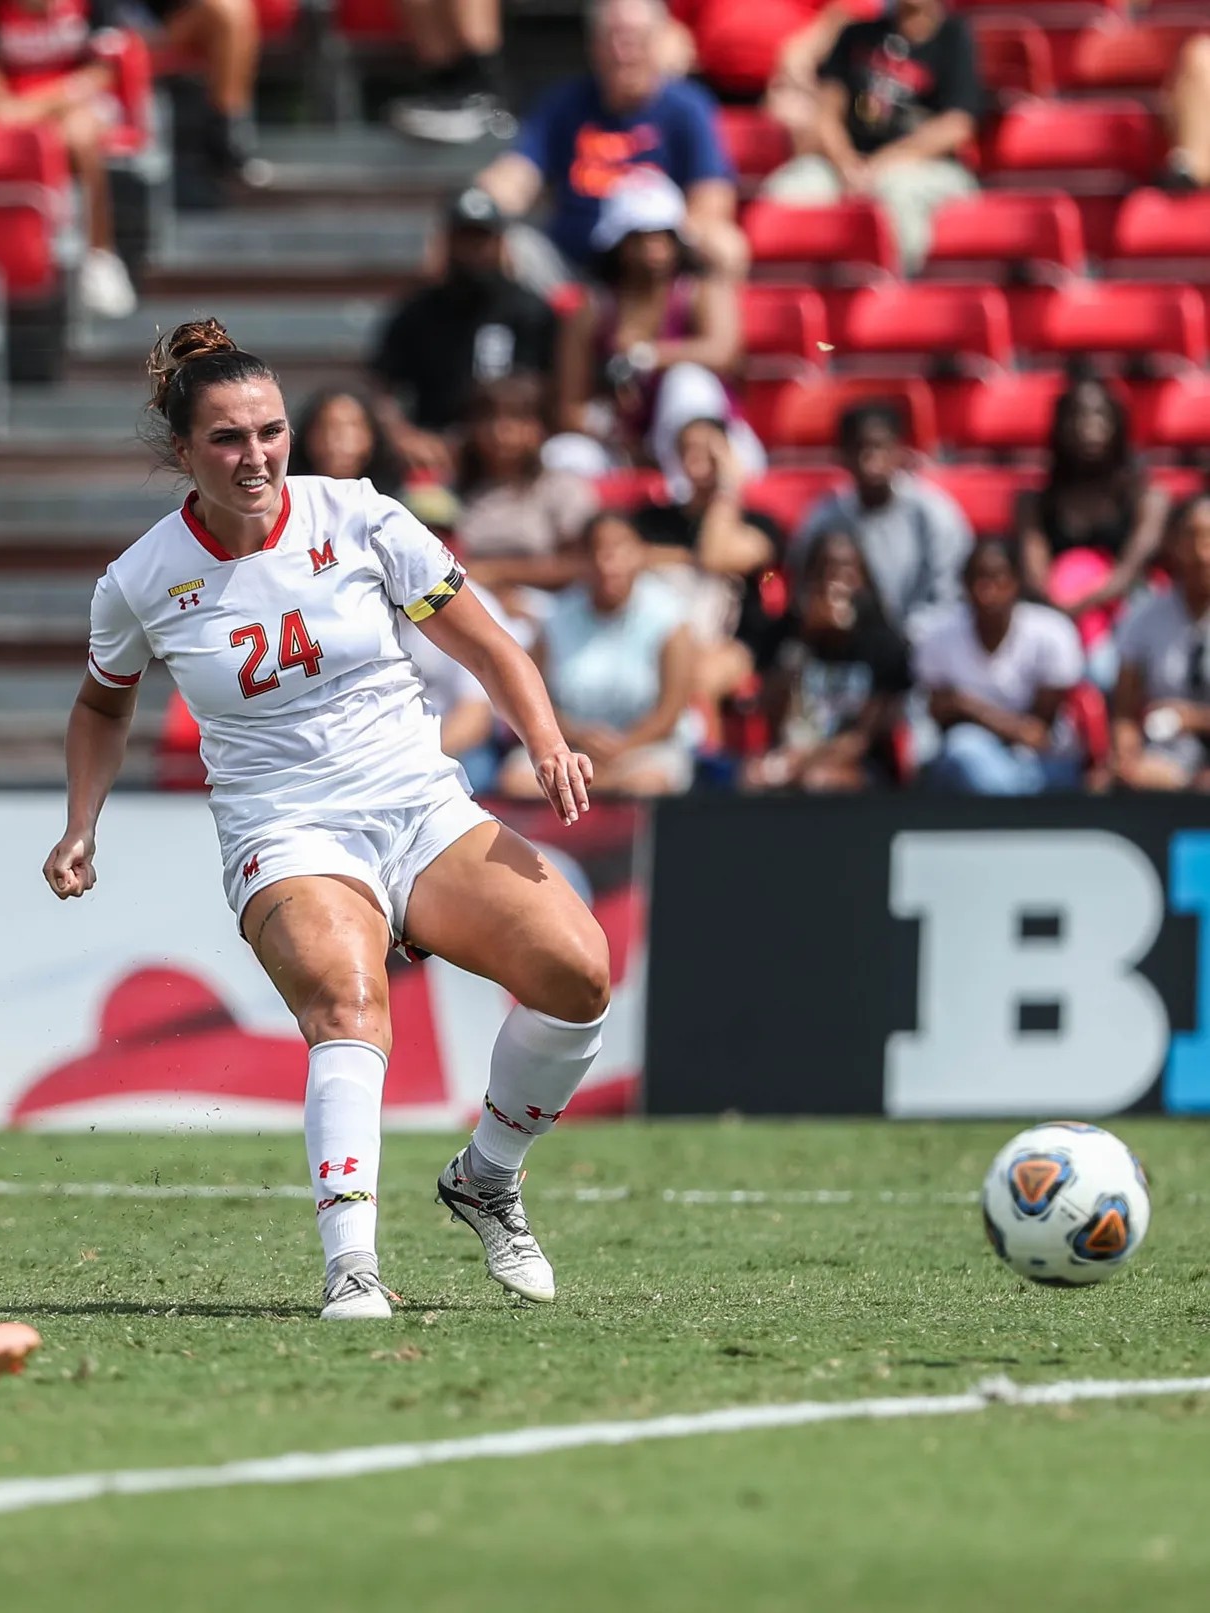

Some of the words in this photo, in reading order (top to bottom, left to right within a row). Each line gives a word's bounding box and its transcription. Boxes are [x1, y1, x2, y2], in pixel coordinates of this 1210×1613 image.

[307, 538, 338, 576] M
[169, 579, 204, 596] GRADUATE
[229, 609, 324, 699] 24
